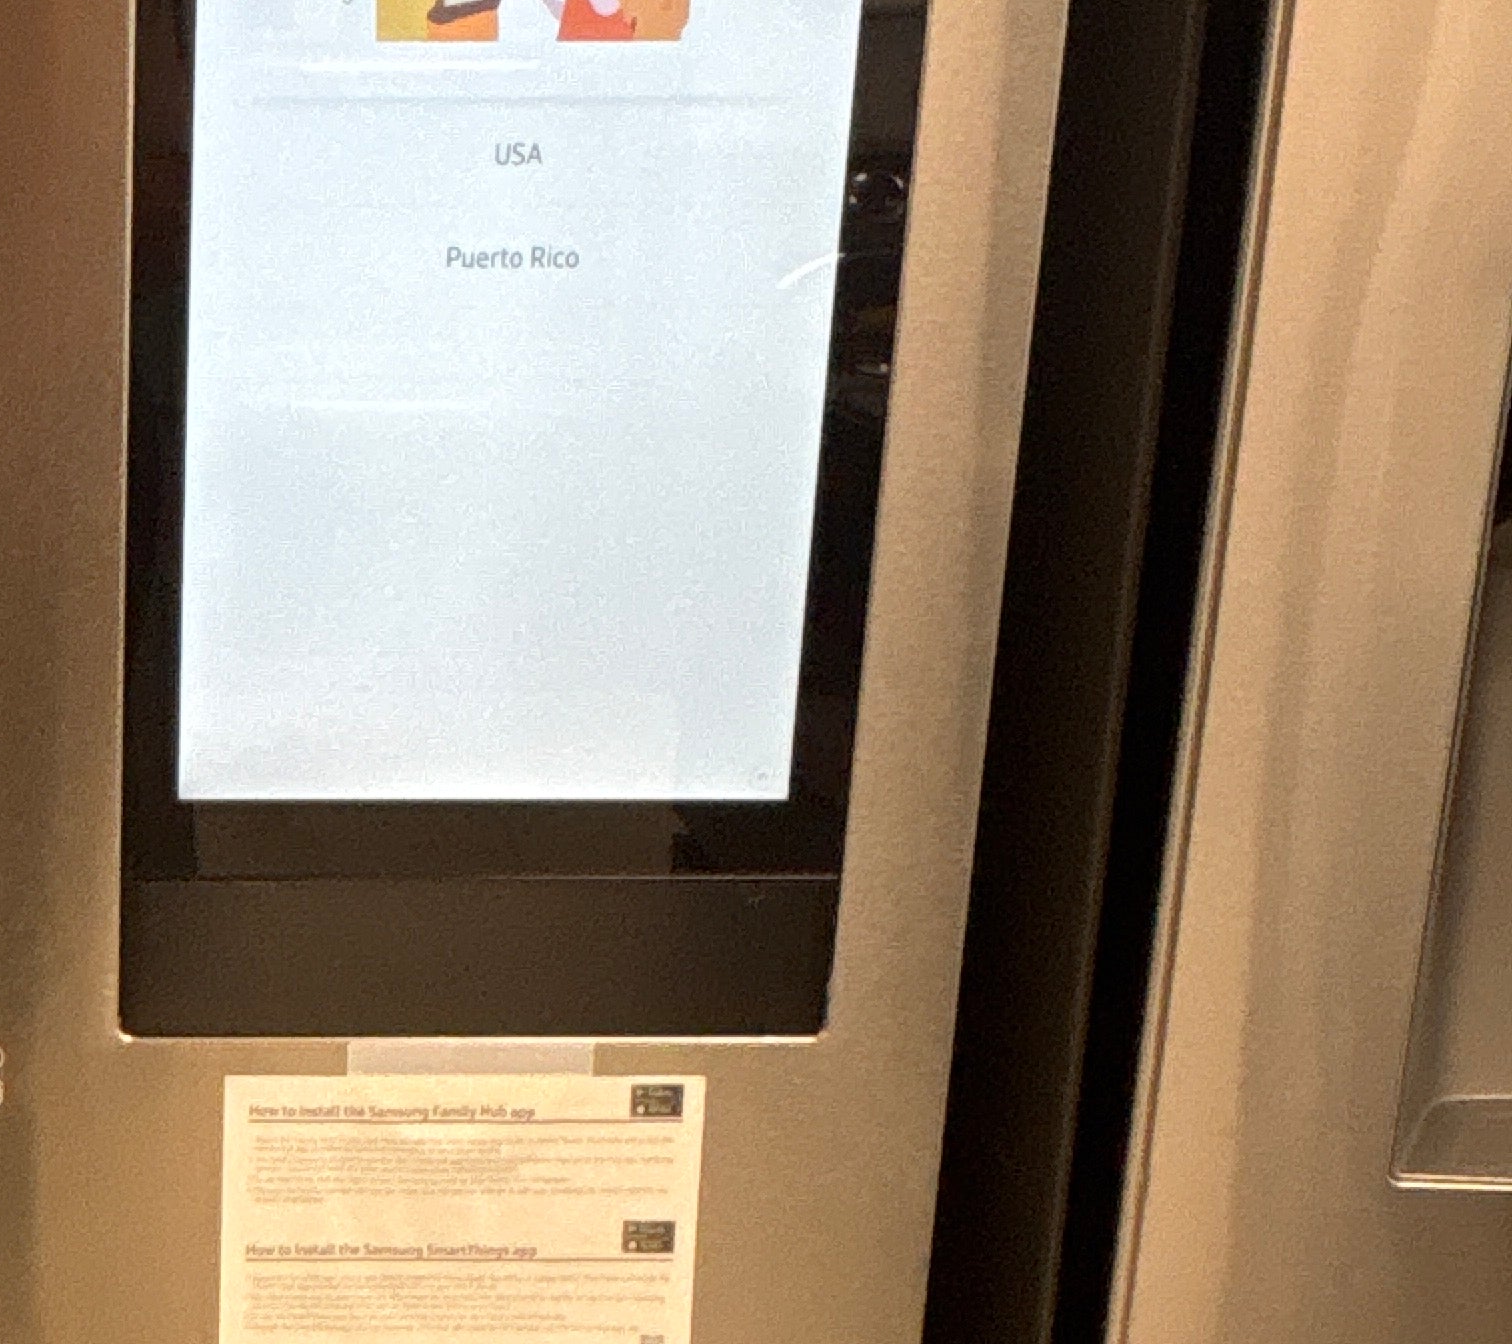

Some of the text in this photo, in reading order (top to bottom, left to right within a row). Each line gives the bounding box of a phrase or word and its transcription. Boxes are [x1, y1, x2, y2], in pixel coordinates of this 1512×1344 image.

[494, 142, 543, 166] USA
[446, 244, 581, 270] Puerto Rico
